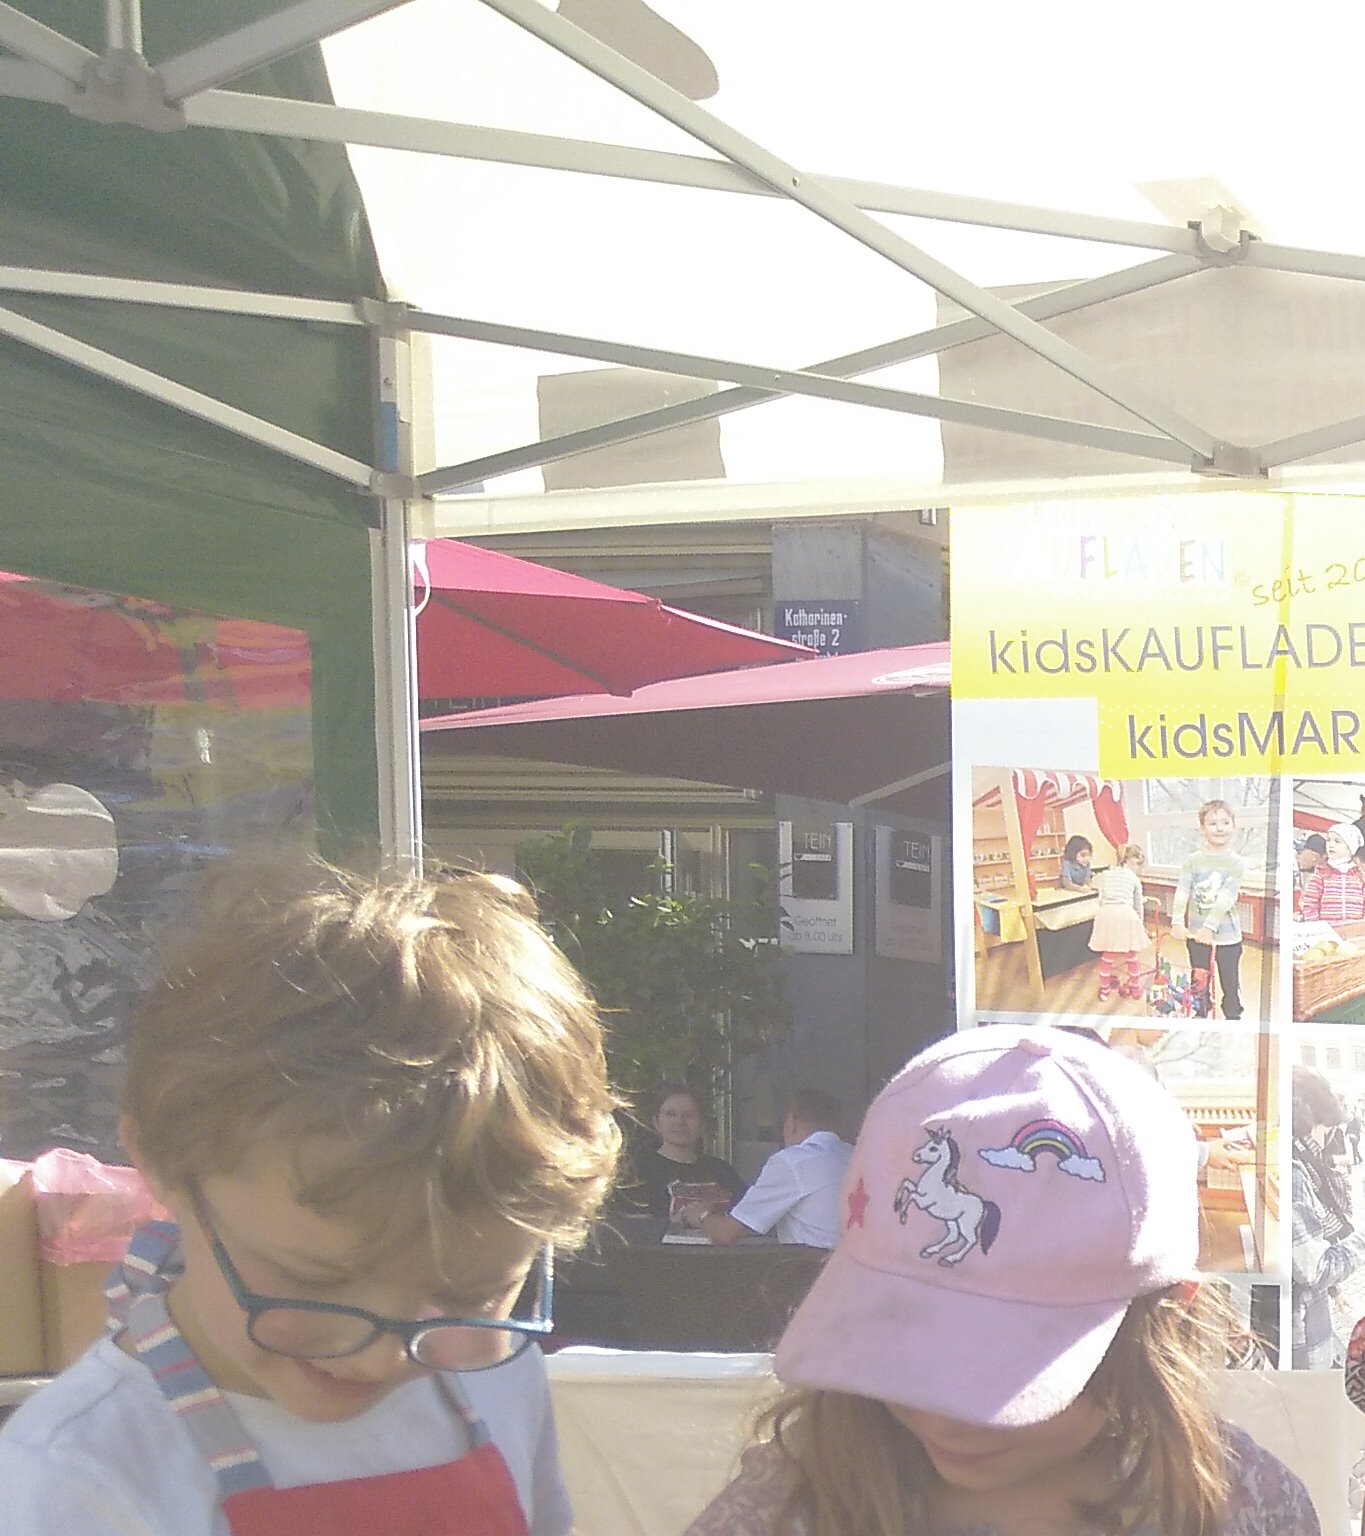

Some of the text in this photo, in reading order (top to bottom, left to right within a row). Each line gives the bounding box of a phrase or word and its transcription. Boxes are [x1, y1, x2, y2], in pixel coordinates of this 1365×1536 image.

[1252, 567, 1315, 607] seit
[785, 608, 849, 626] Katharinen-
[791, 628, 841, 649] straße 2
